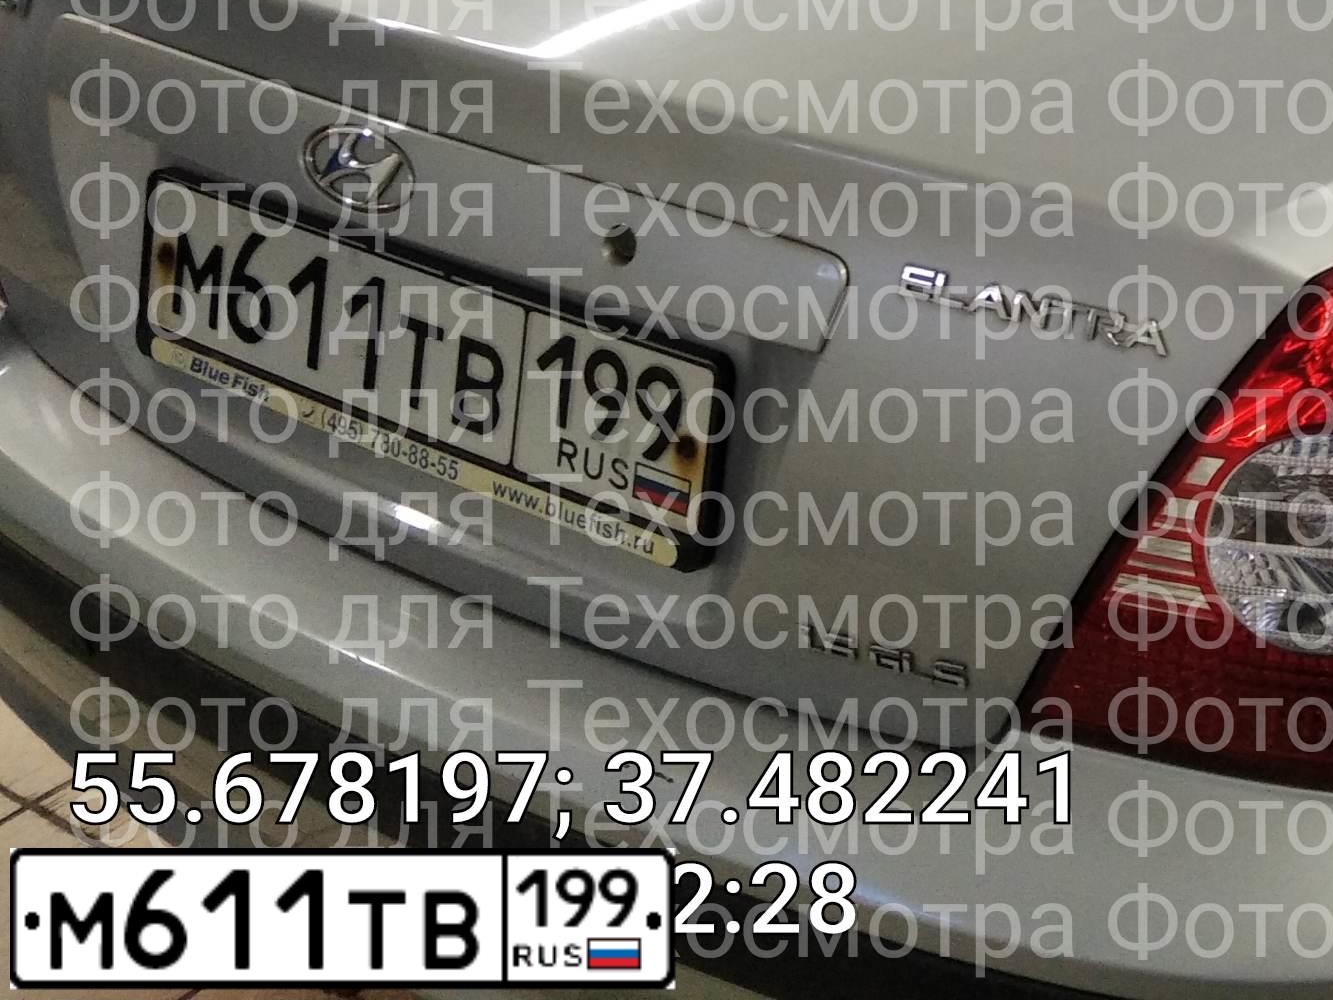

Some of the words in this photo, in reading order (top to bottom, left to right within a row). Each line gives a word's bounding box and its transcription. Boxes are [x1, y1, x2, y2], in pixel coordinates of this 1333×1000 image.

[897, 262, 1170, 358] ELANTRA
[190, 356, 230, 385] Blue
[537, 335, 682, 461] 199
[556, 437, 629, 490] RUS
